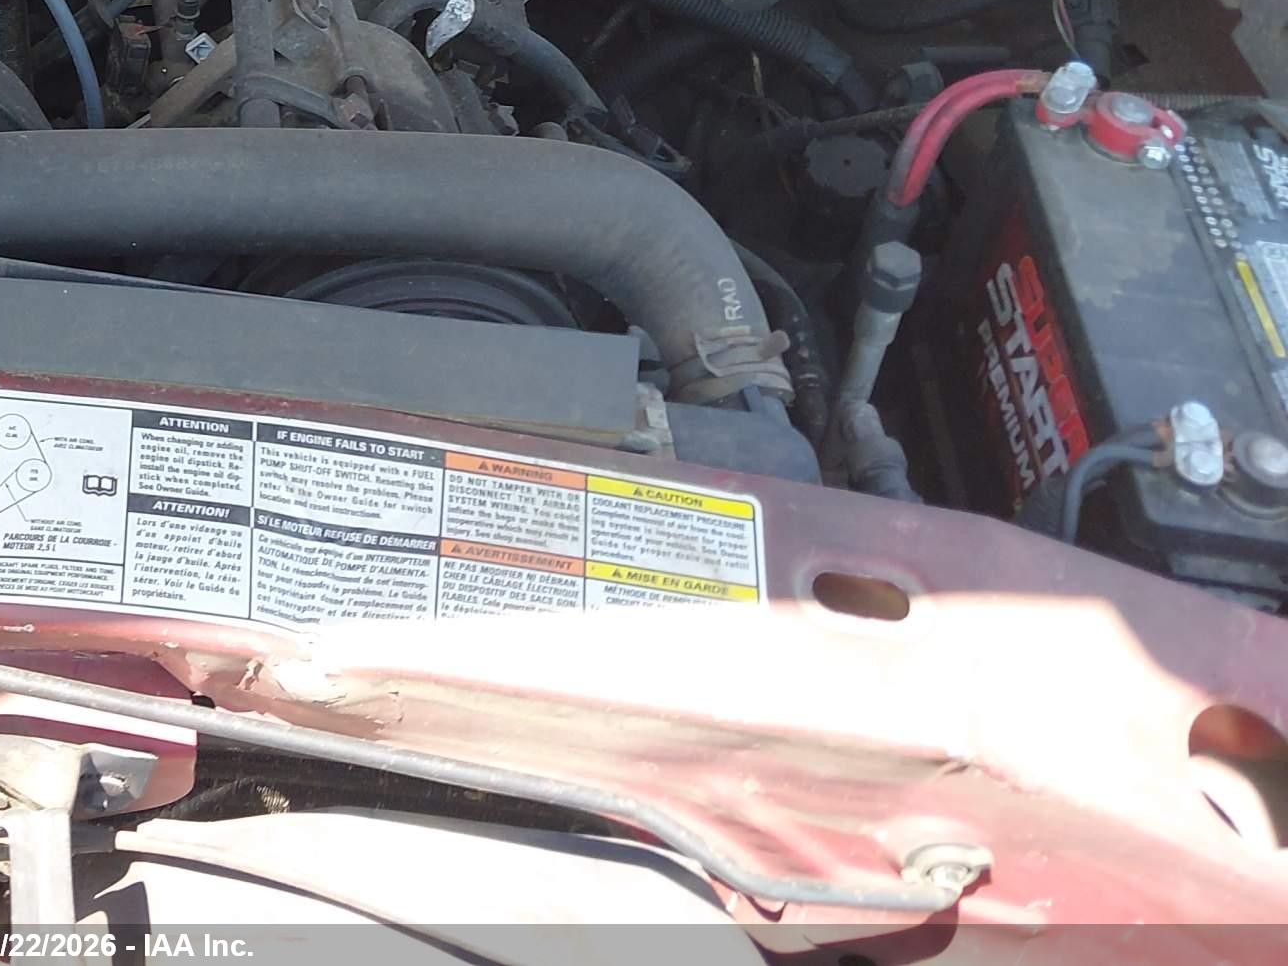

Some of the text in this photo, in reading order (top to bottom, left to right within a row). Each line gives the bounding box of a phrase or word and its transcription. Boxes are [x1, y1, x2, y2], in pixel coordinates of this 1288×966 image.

[986, 262, 1070, 477] START
[1018, 256, 1089, 468] SUPER
[977, 317, 1035, 489] PREMIUM
[159, 416, 228, 432] ATTENTION
[141, 432, 164, 442] When
[166, 435, 203, 447] changing
[277, 429, 424, 460] IF ENGINE FAILS TO START
[140, 443, 170, 453] engine
[192, 449, 225, 458] remove
[229, 452, 242, 460] the
[140, 452, 169, 463] engine
[172, 455, 183, 463] oil
[139, 472, 160, 481] stick
[164, 474, 188, 484] when
[167, 465, 179, 473] the
[183, 468, 210, 478] engine
[213, 470, 223, 478] oil
[492, 463, 552, 481] WARNING
[138, 481, 153, 490] See
[156, 483, 183, 493] Owner
[646, 489, 702, 507] CAUTION
[152, 500, 229, 518] ATTENTION!
[257, 514, 267, 525] SI
[268, 517, 280, 528] LE
[282, 520, 321, 535] MOTEUR
[324, 527, 362, 541] REFUSE
[363, 533, 377, 543] DE
[2, 540, 34, 550] MOTEUR
[3, 531, 44, 542] PARCOURS
[47, 534, 57, 542] DE
[59, 535, 69, 543] LA
[72, 536, 111, 546] COURROIE
[464, 545, 573, 570] AVERTISSEMENT
[626, 570, 726, 594] MISE EN GARDE
